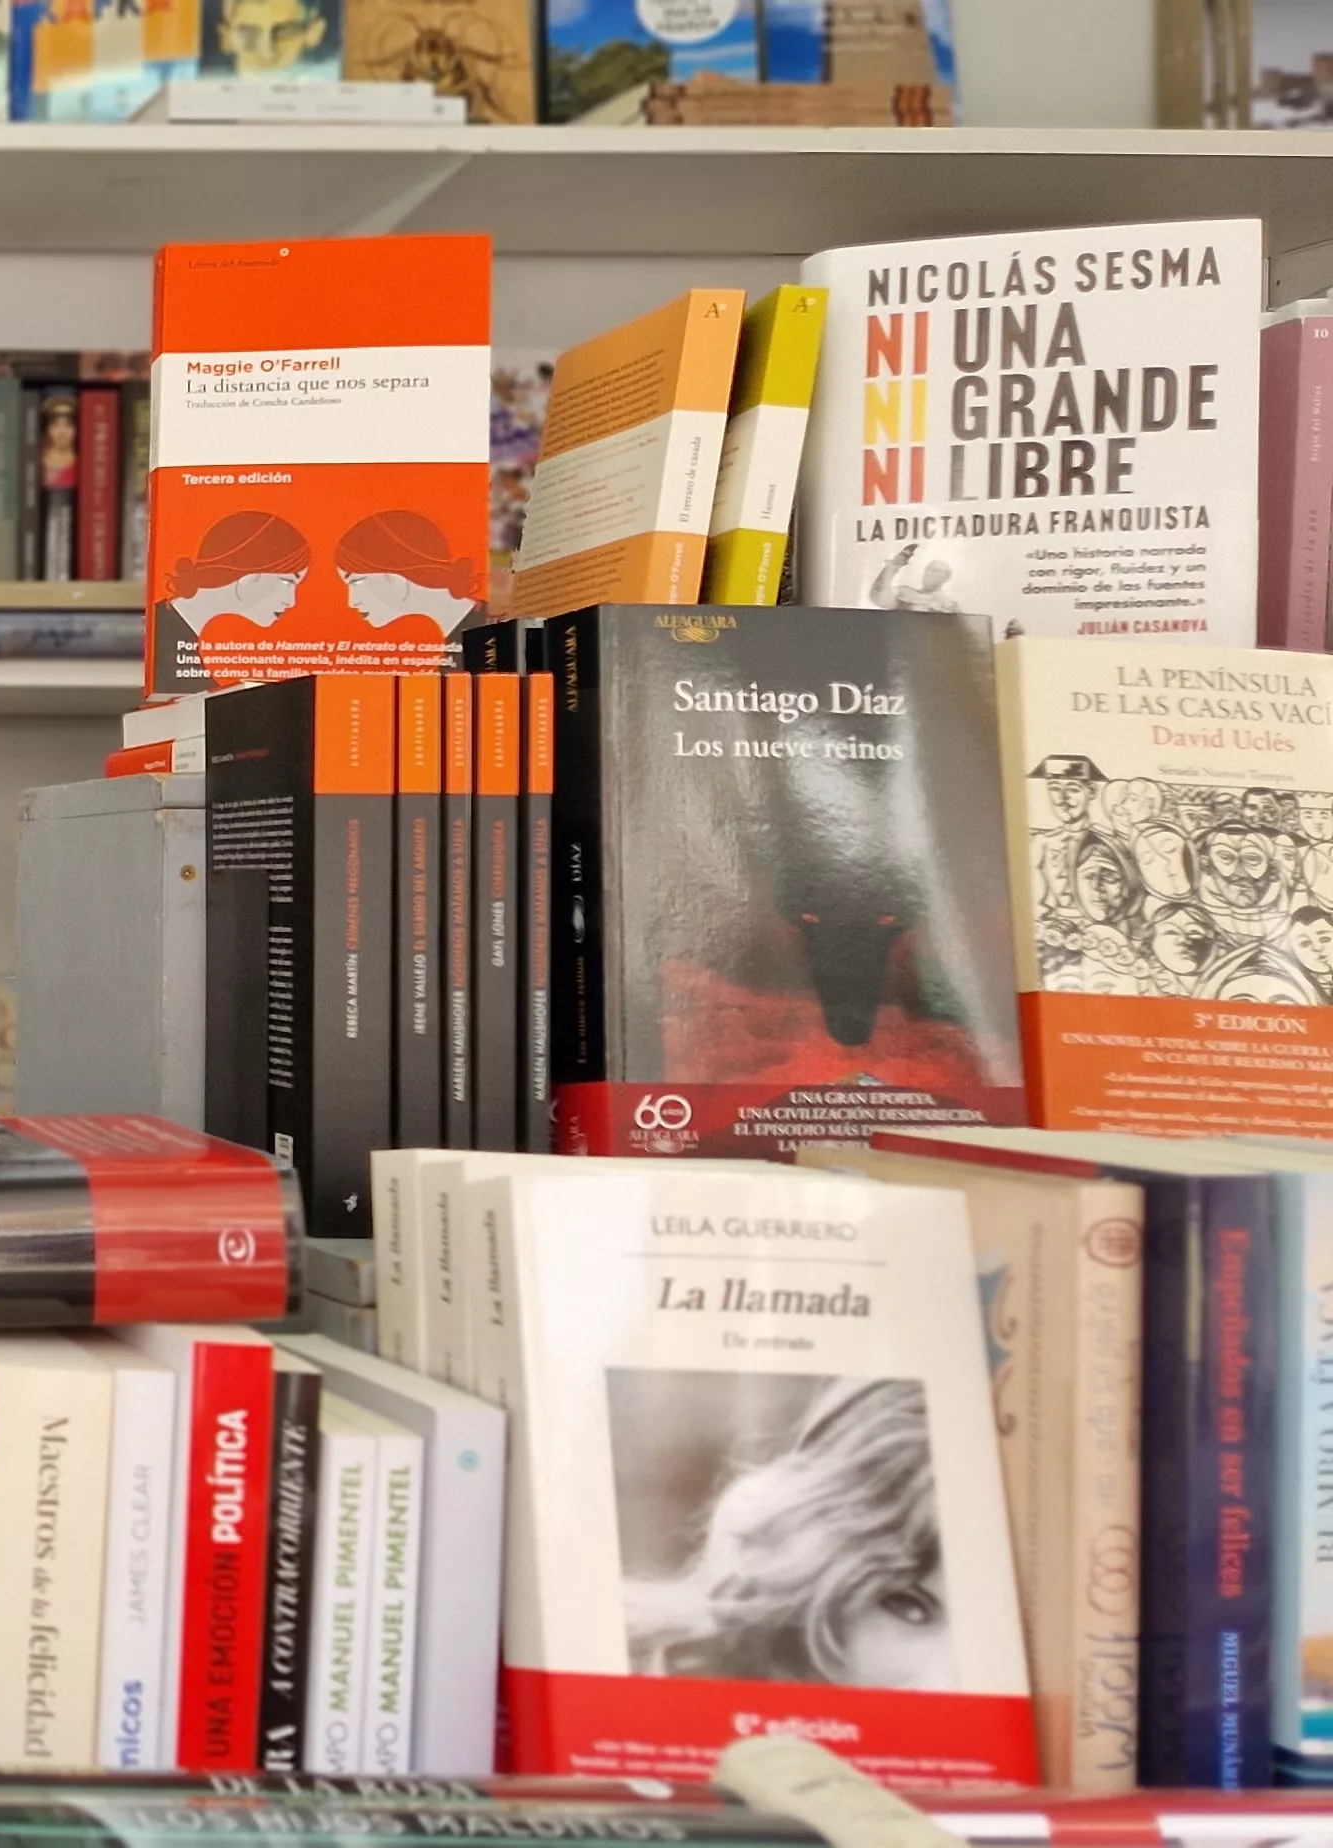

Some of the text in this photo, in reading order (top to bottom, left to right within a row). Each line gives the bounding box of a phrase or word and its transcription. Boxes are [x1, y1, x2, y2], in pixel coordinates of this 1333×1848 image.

[868, 246, 1221, 307] NICOLÁS SESMA
[865, 302, 1086, 378] NI UNA
[186, 376, 430, 395] La distancia que nos separa
[187, 360, 253, 376] Maggie
[863, 364, 1219, 445] NI GRANDE
[182, 471, 293, 486] Tercera edición
[861, 437, 1137, 506] NI LIBRE
[855, 505, 1211, 543] LA DICTADURA FRANQUISTA
[1022, 577, 1206, 595] dominio de las fuentes
[1028, 562, 1207, 580] con rigor, fluidez y un
[1077, 615, 1209, 636] JULIÁN CASANOVA
[176, 654, 201, 665] Una
[204, 655, 285, 666] emocionante
[288, 655, 333, 667] novela,
[336, 654, 380, 666] inédita
[384, 656, 400, 666] en
[177, 640, 463, 654] Por la autora de Hamnet y El retrato de casada
[176, 667, 309, 679] sobre cómo la familia
[1116, 666, 1317, 698] LA PENÍNSULA
[674, 680, 907, 723] Santiago Díaz
[1073, 692, 1333, 726] DE LAS CASAS VACÍ
[673, 732, 905, 761] Los nueve reinos
[1152, 725, 1297, 752] David Uclés
[387, 1176, 403, 1286] La llamada
[650, 1215, 859, 1243] LEILA GUERRIERO
[484, 1208, 505, 1328] La llamada
[657, 1276, 873, 1320] La llamada
[1216, 1227, 1252, 1598] Empeñados en ser felices
[269, 1421, 308, 1700] A CONTRACORRIENTE
[23, 1413, 69, 1760] Maestros de la felicidad
[202, 1407, 249, 1759] UNA EMOCIÓN POLÍTICA
[328, 1461, 364, 1713] MANUEL PIMENTEL
[377, 1464, 411, 1715] MANUEL PIMENTEL
